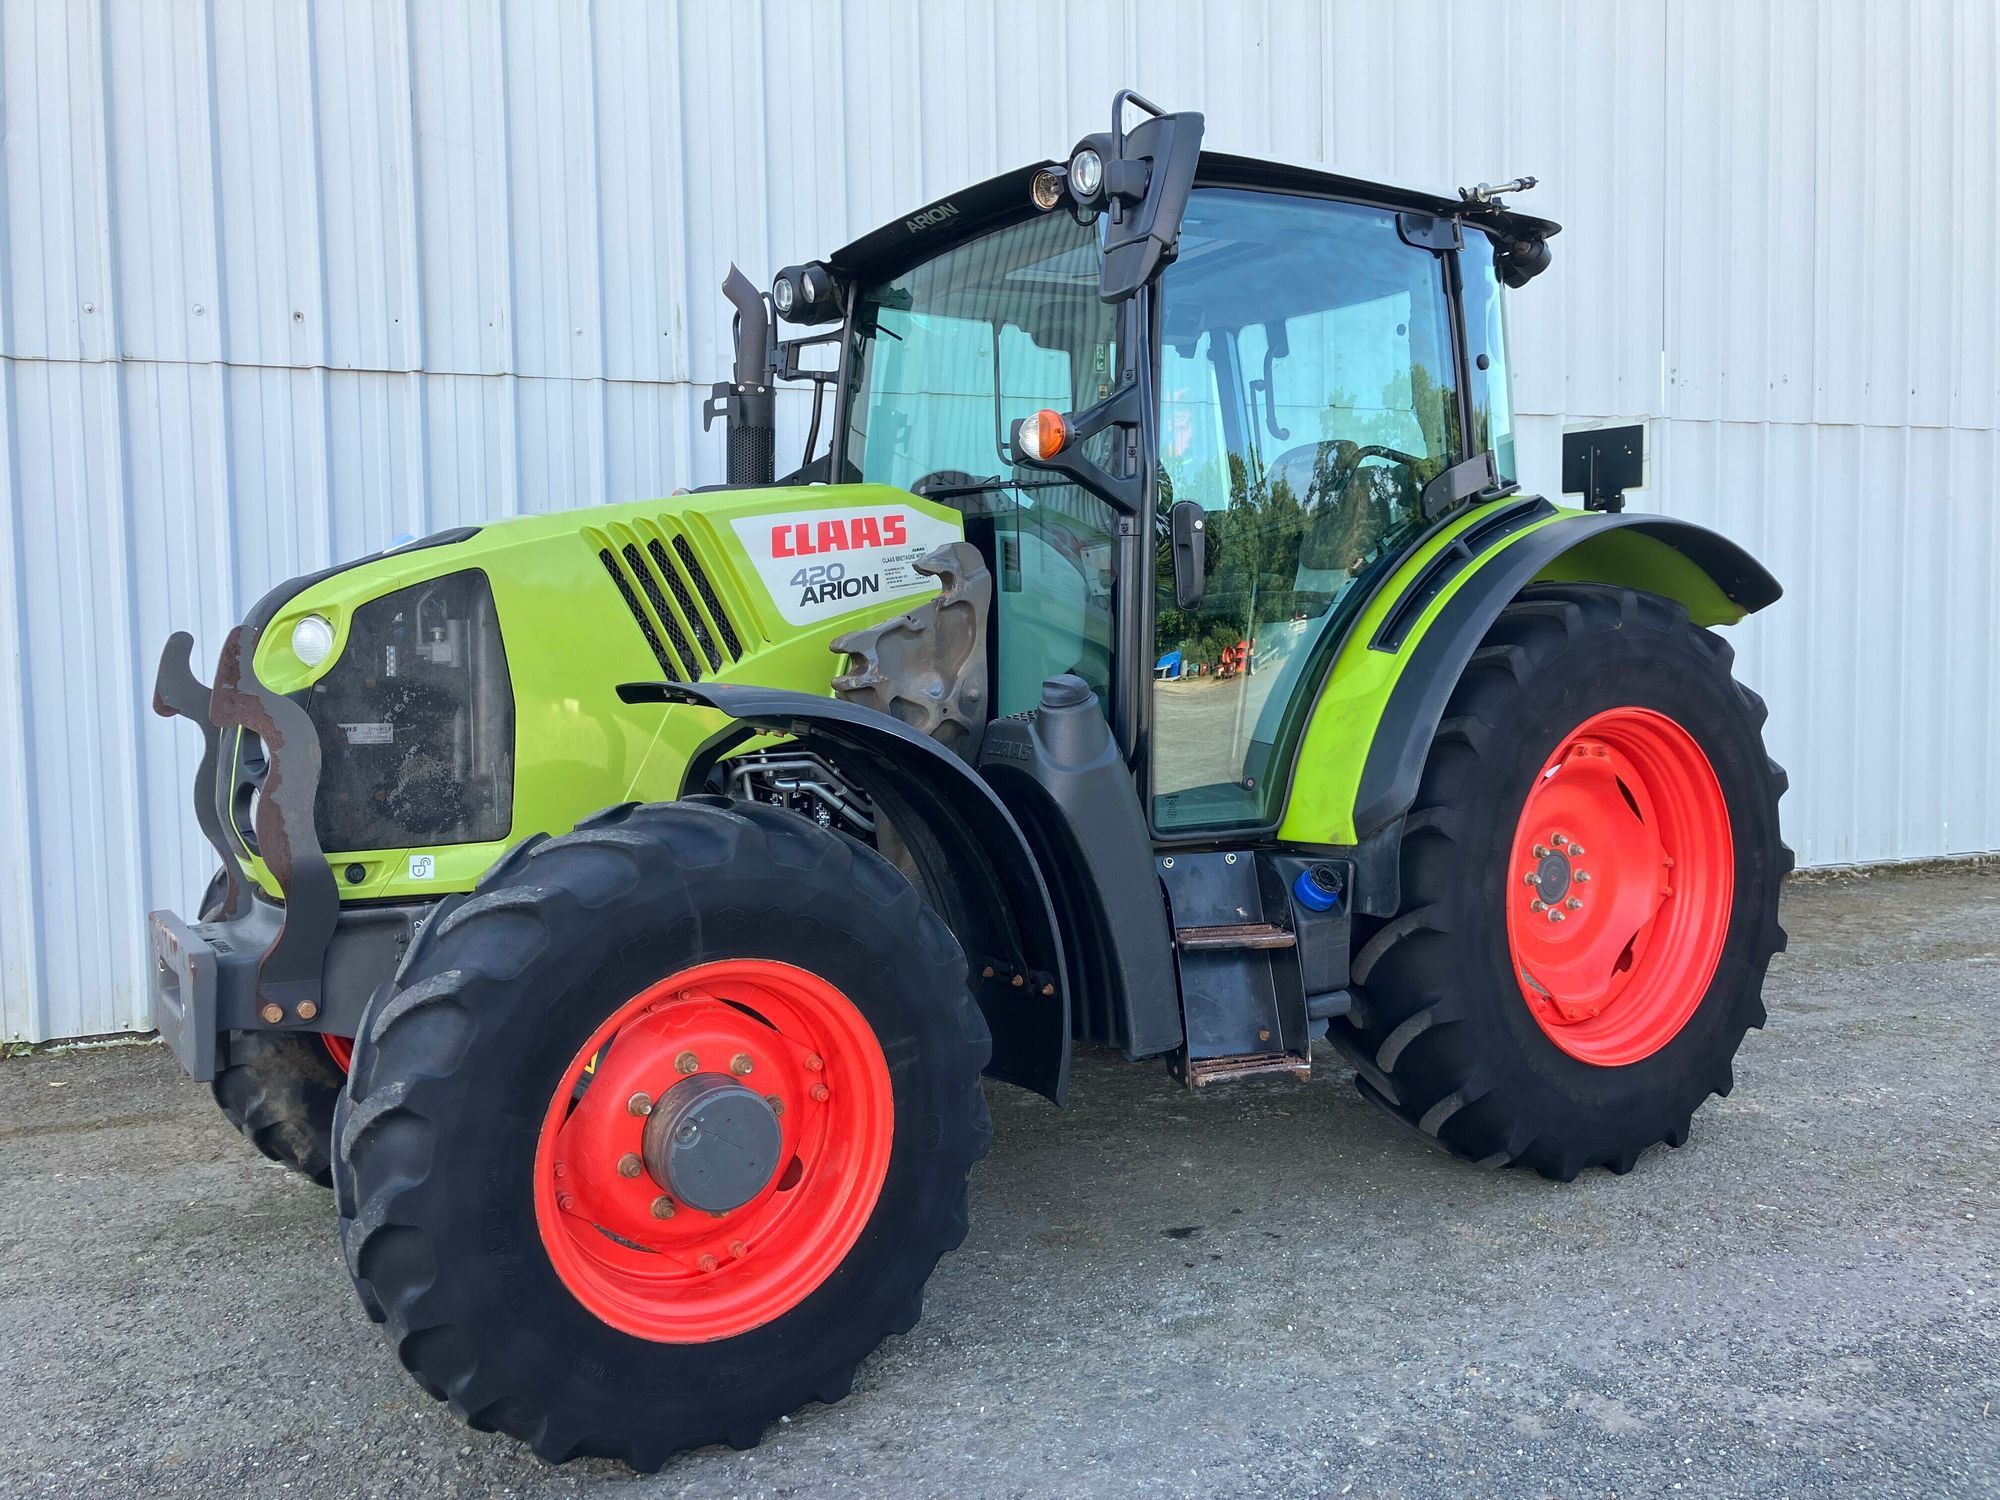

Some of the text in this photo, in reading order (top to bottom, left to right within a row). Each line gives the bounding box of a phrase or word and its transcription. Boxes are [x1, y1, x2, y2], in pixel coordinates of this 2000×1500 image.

[905, 202, 959, 233] ARION
[771, 514, 907, 559] CLAAS
[895, 553, 915, 562] BRETAGNE
[790, 562, 846, 588] 420
[799, 573, 879, 608] ARION
